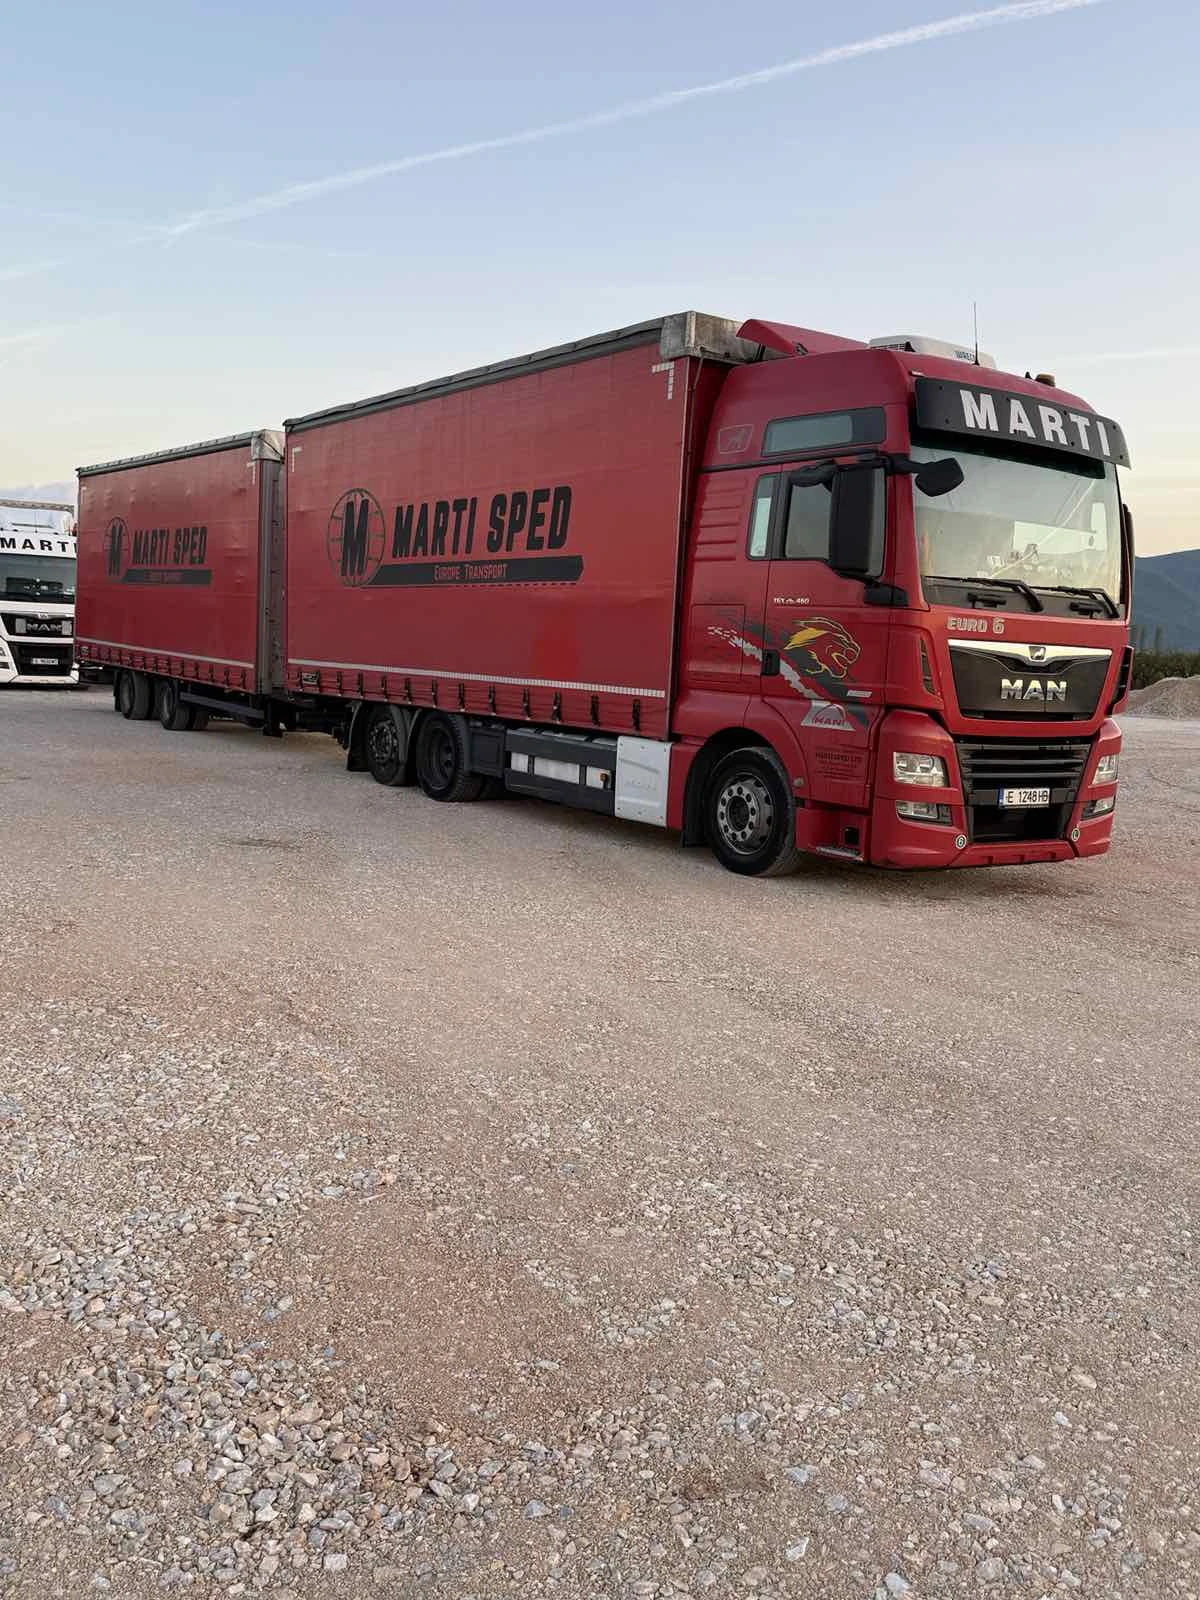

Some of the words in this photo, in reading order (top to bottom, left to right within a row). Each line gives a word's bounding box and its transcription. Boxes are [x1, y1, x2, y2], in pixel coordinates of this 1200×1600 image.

[959, 388, 1111, 457] MARTI
[391, 496, 478, 558] MARTI
[486, 486, 572, 552] SPED
[0, 537, 77, 552] MARTI
[132, 528, 170, 565] MARTI
[173, 526, 207, 564] SPED
[26, 623, 62, 632] MAN
[947, 616, 988, 633] EURO
[992, 617, 1005, 634] 6
[1001, 679, 1067, 701] MAN
[814, 717, 842, 726] MAN
